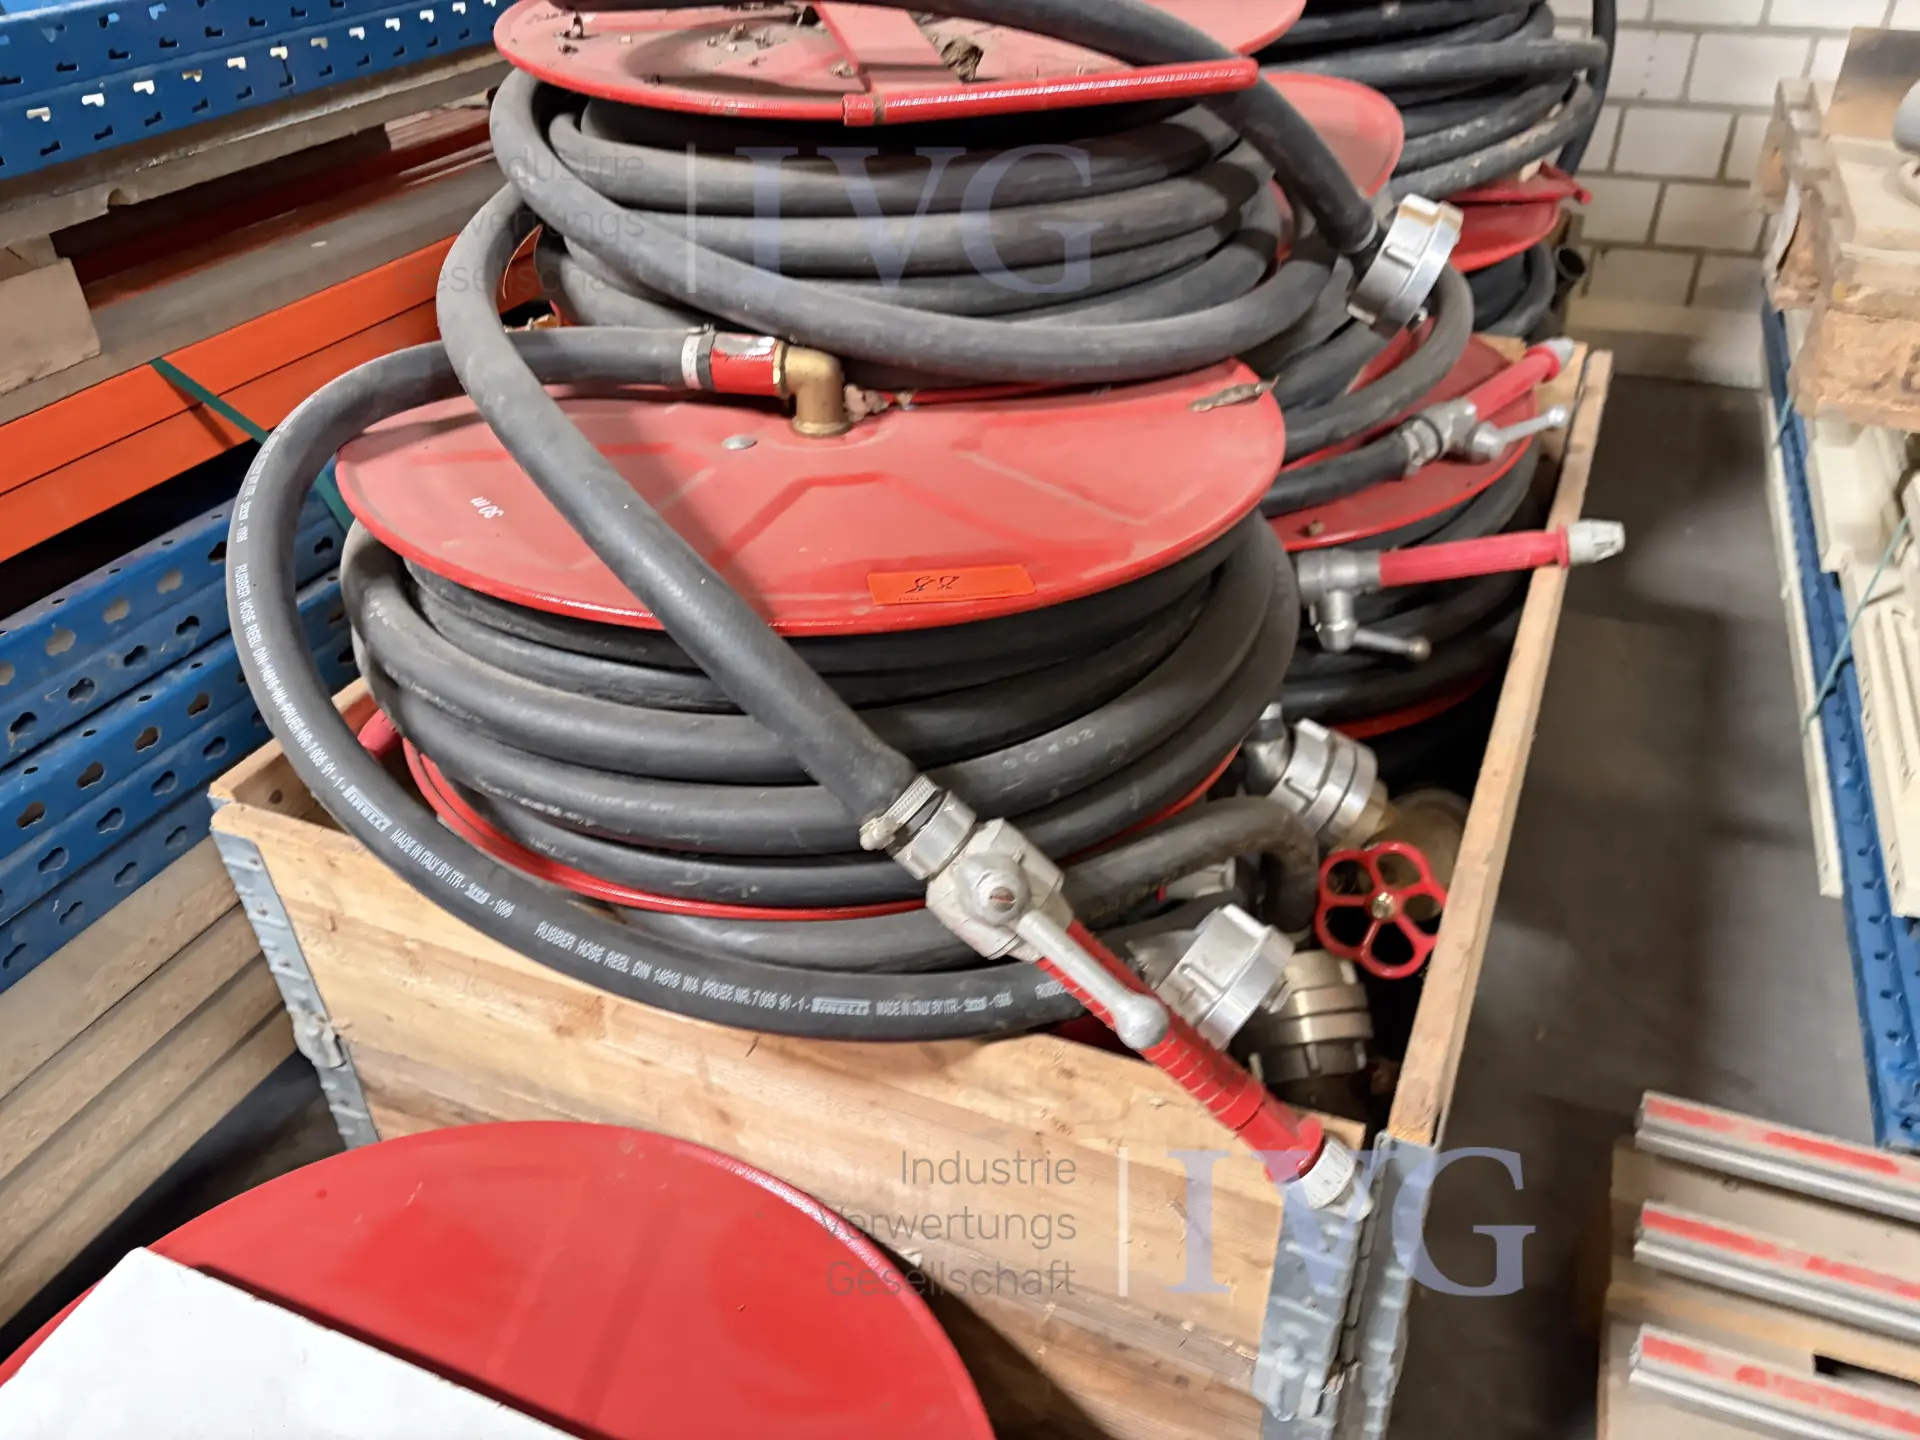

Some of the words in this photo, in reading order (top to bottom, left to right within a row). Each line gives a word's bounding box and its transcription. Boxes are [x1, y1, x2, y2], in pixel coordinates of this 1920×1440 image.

[236, 563, 250, 599] RUBBER
[239, 599, 256, 625] HOSE
[245, 623, 262, 649] REEL
[252, 647, 270, 665] DIN
[389, 827, 416, 855] MADE
[417, 848, 442, 873] ITALY
[435, 860, 453, 879] BY
[534, 920, 577, 951] RUBBER
[574, 937, 606, 963] HOSE
[603, 949, 630, 973] REEL
